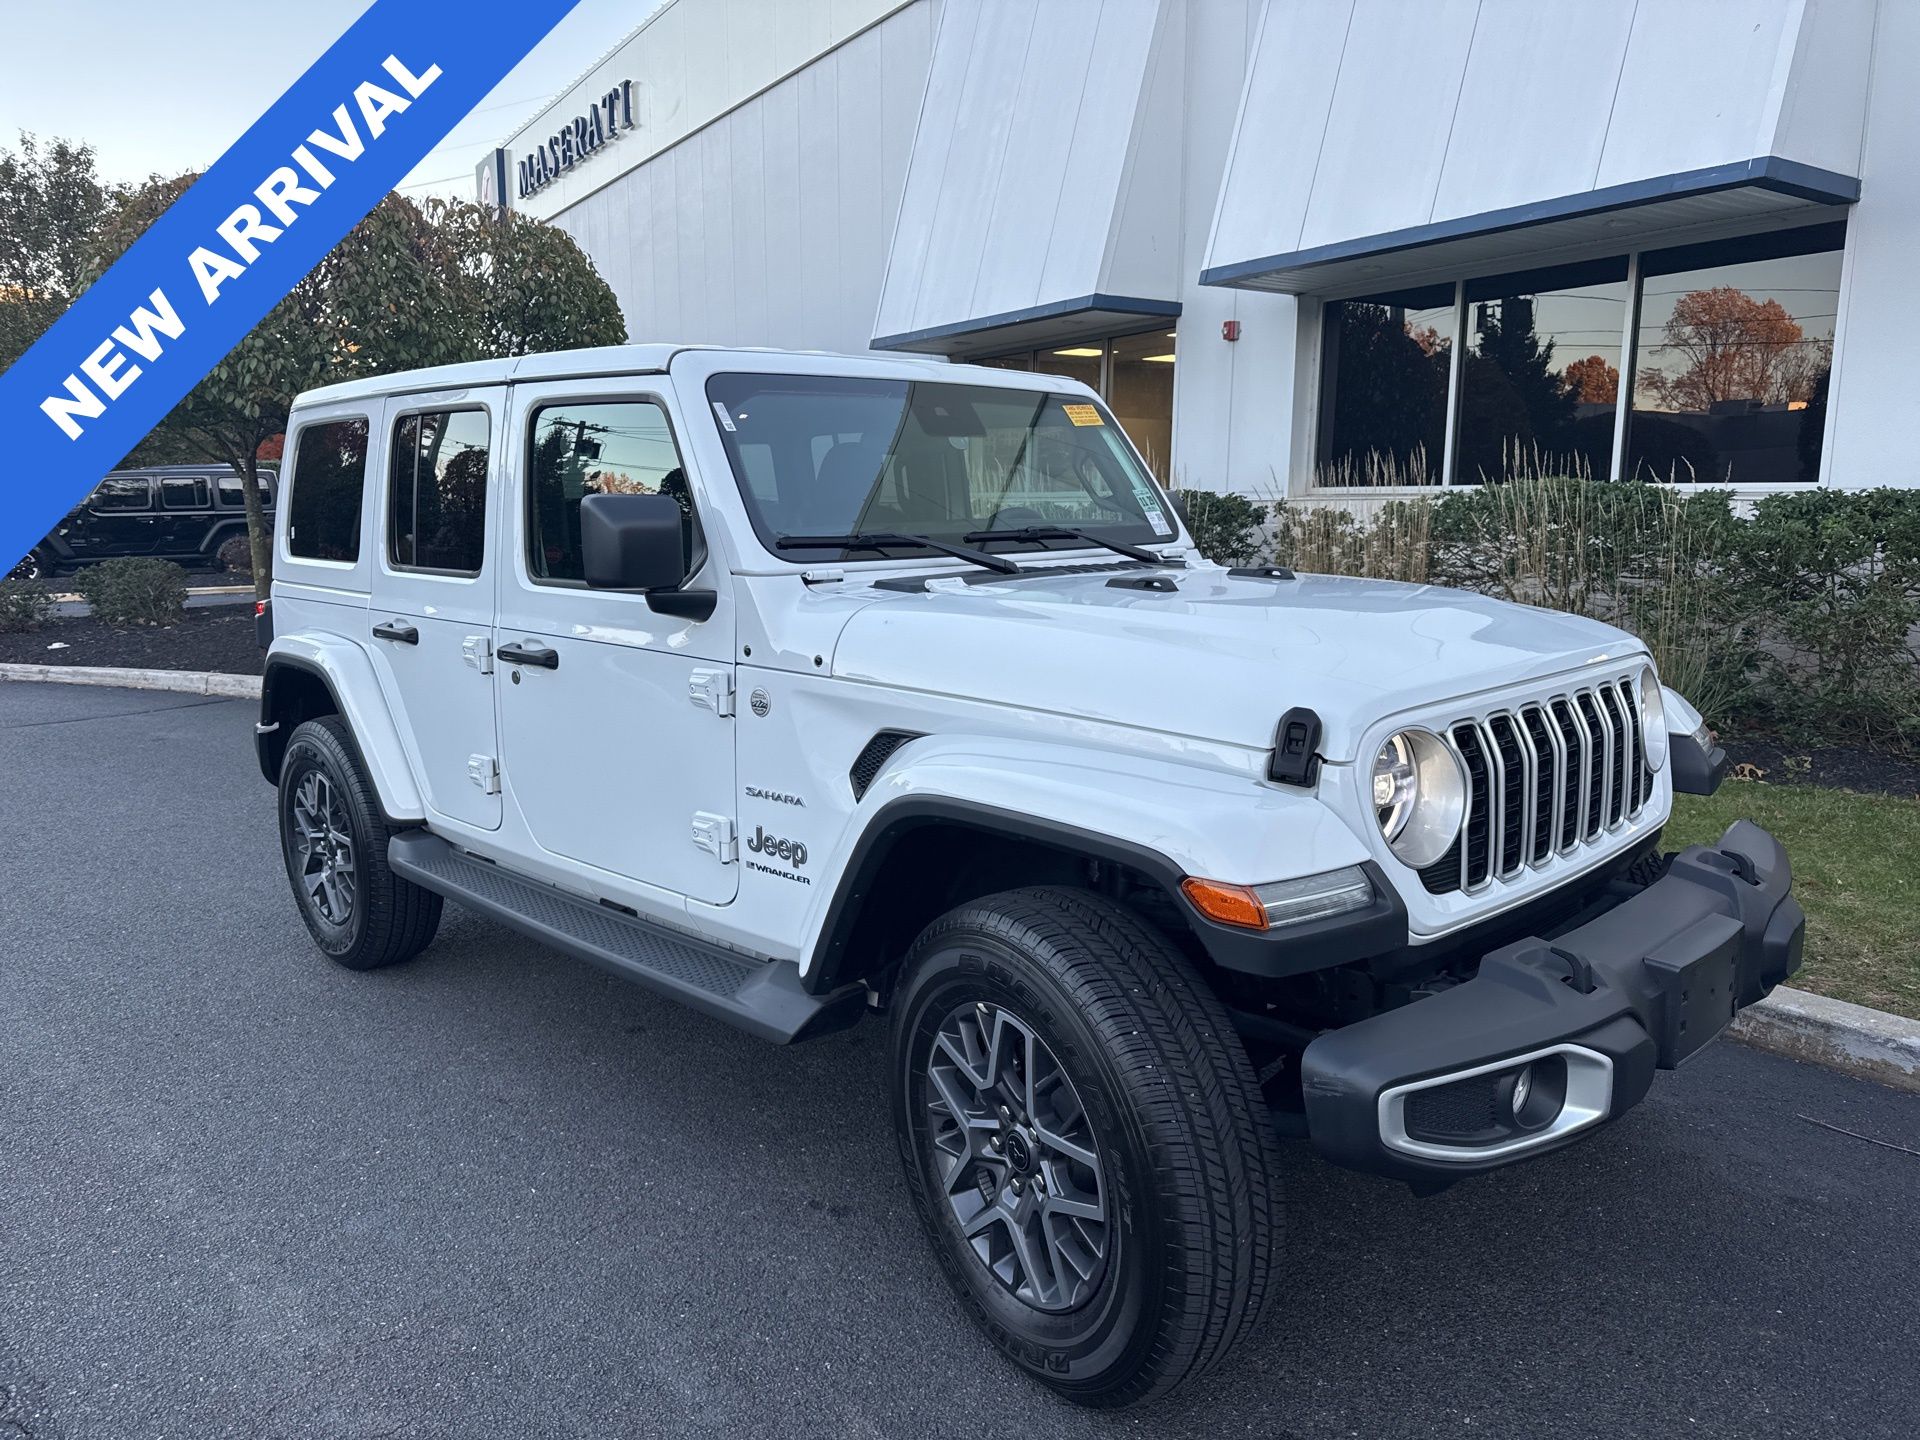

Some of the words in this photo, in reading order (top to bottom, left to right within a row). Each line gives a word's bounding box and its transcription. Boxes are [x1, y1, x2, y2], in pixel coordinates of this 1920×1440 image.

[518, 79, 634, 199] MASERATI
[745, 786, 807, 808] SAHARA
[747, 825, 808, 869] Jeep
[755, 863, 811, 885] WRANGLER
